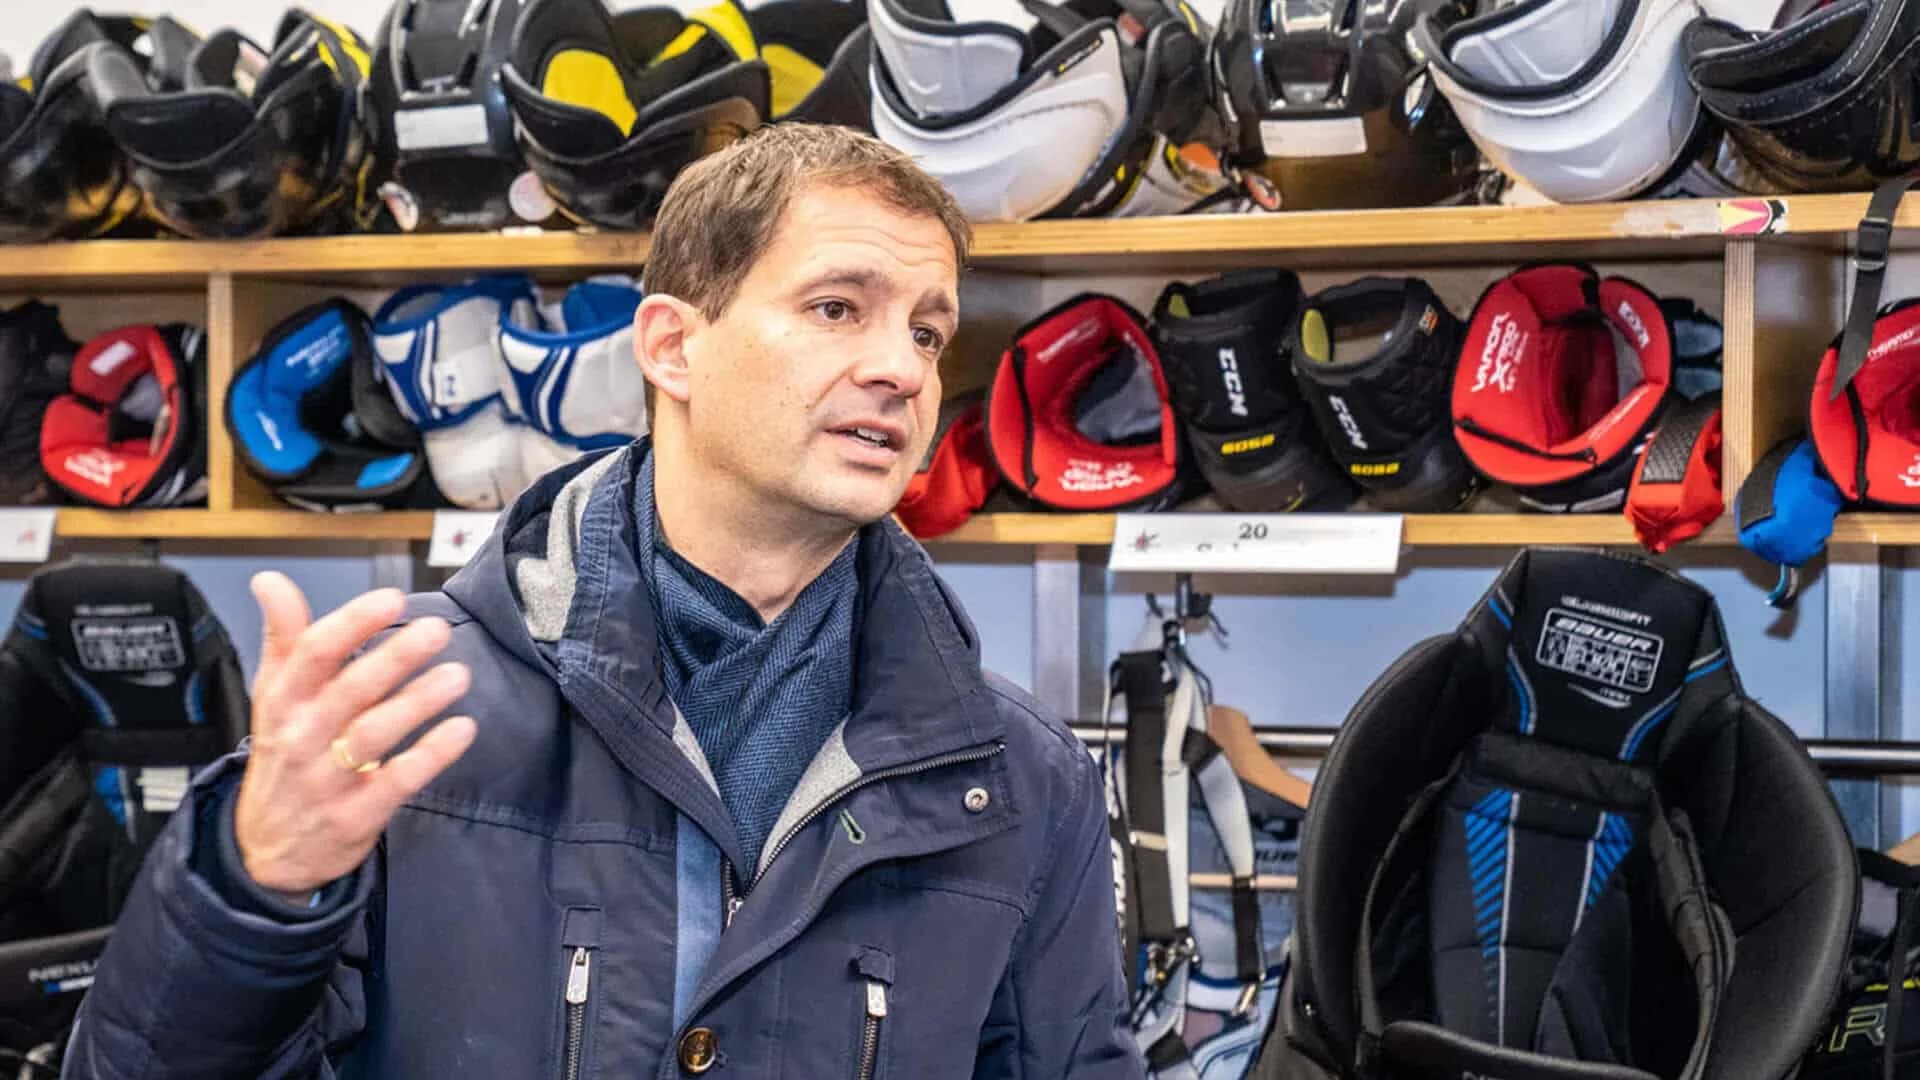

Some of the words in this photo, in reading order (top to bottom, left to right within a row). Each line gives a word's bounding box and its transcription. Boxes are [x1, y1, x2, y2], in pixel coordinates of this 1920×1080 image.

[1471, 312, 1511, 392] VAPOR
[1218, 347, 1249, 416] CCM
[1328, 394, 1368, 449] CCM
[1238, 522, 1269, 541] 20
[1555, 617, 1653, 652] BAUER
[28, 959, 98, 983] NEXU
